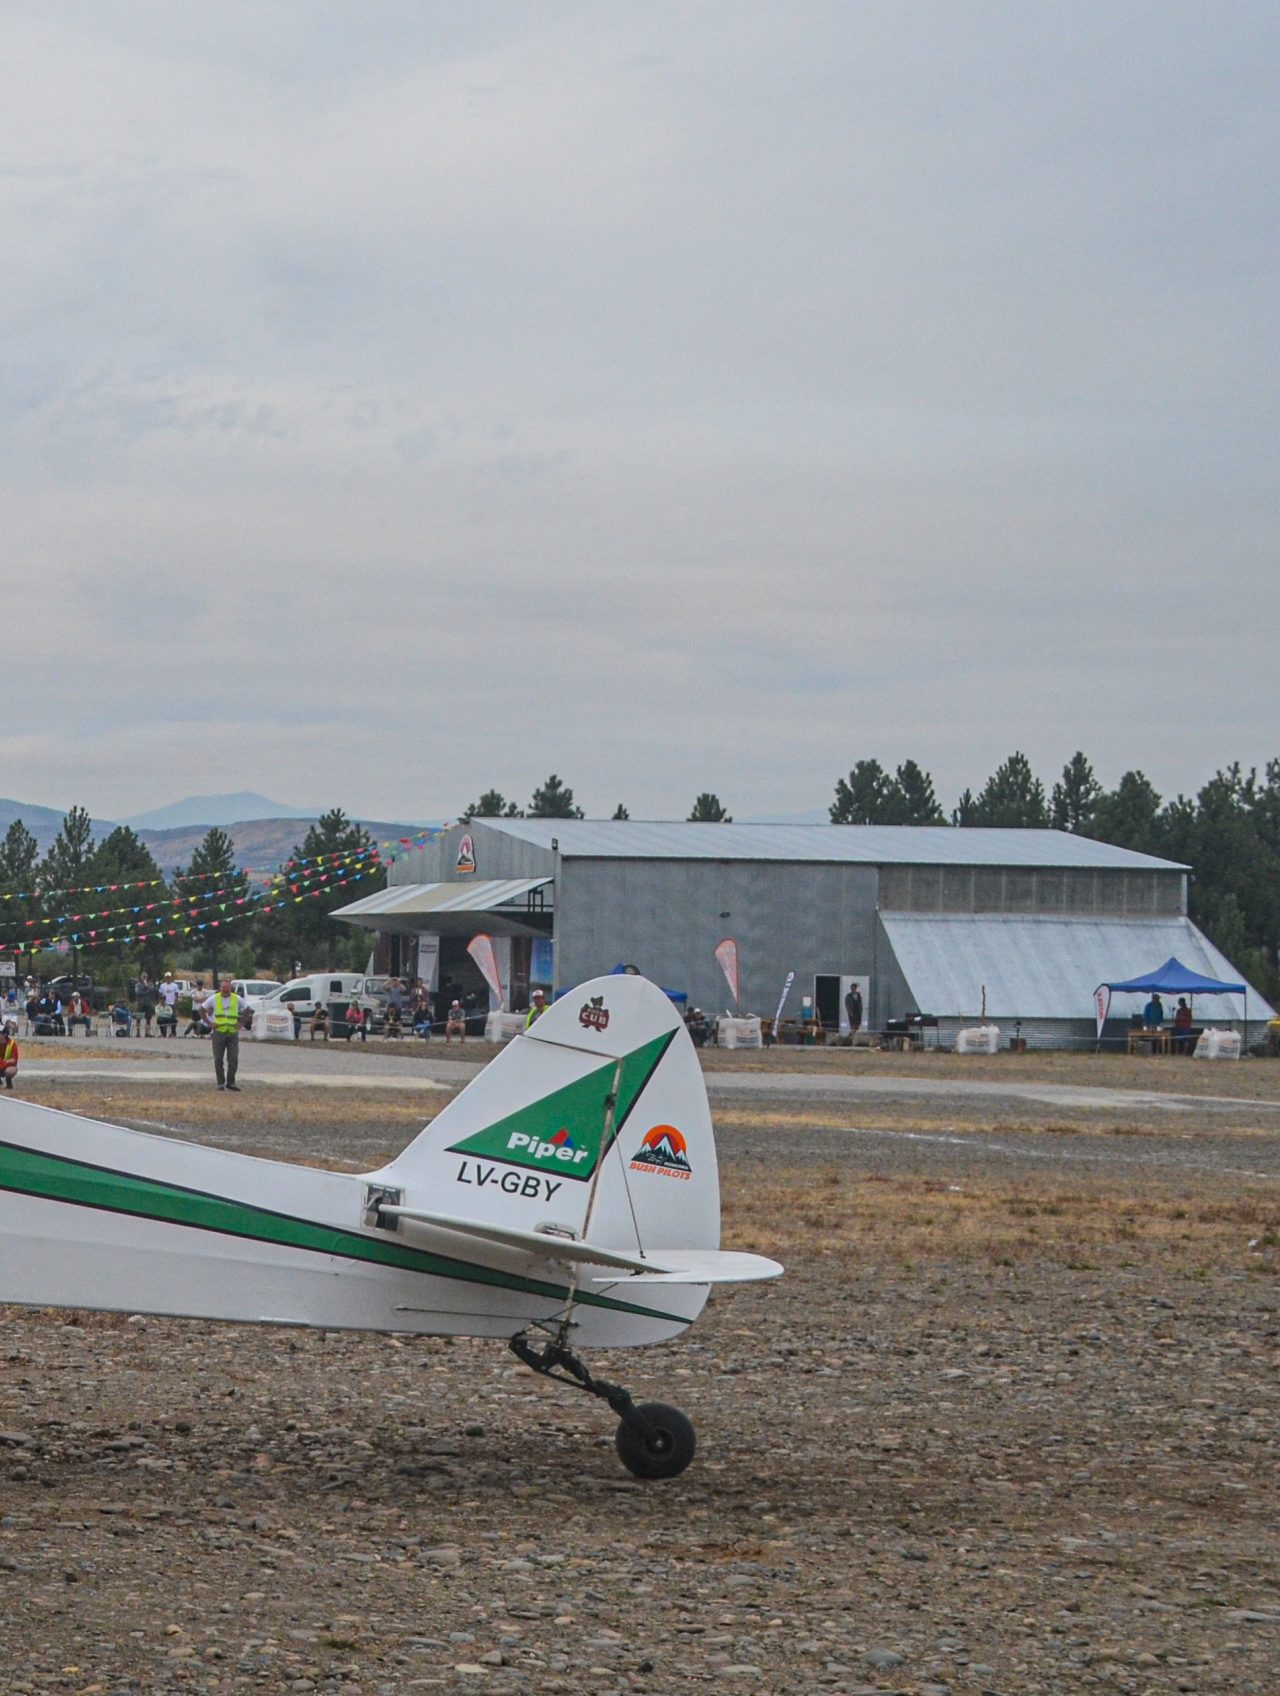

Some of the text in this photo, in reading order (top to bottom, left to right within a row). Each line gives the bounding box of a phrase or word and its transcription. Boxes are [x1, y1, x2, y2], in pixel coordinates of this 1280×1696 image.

[581, 1011, 607, 1025] CUB
[506, 1131, 589, 1163] Piper
[456, 1161, 562, 1202] LV-GBY
[629, 1162, 656, 1174] BUSH
[657, 1167, 691, 1180] PILOTS
